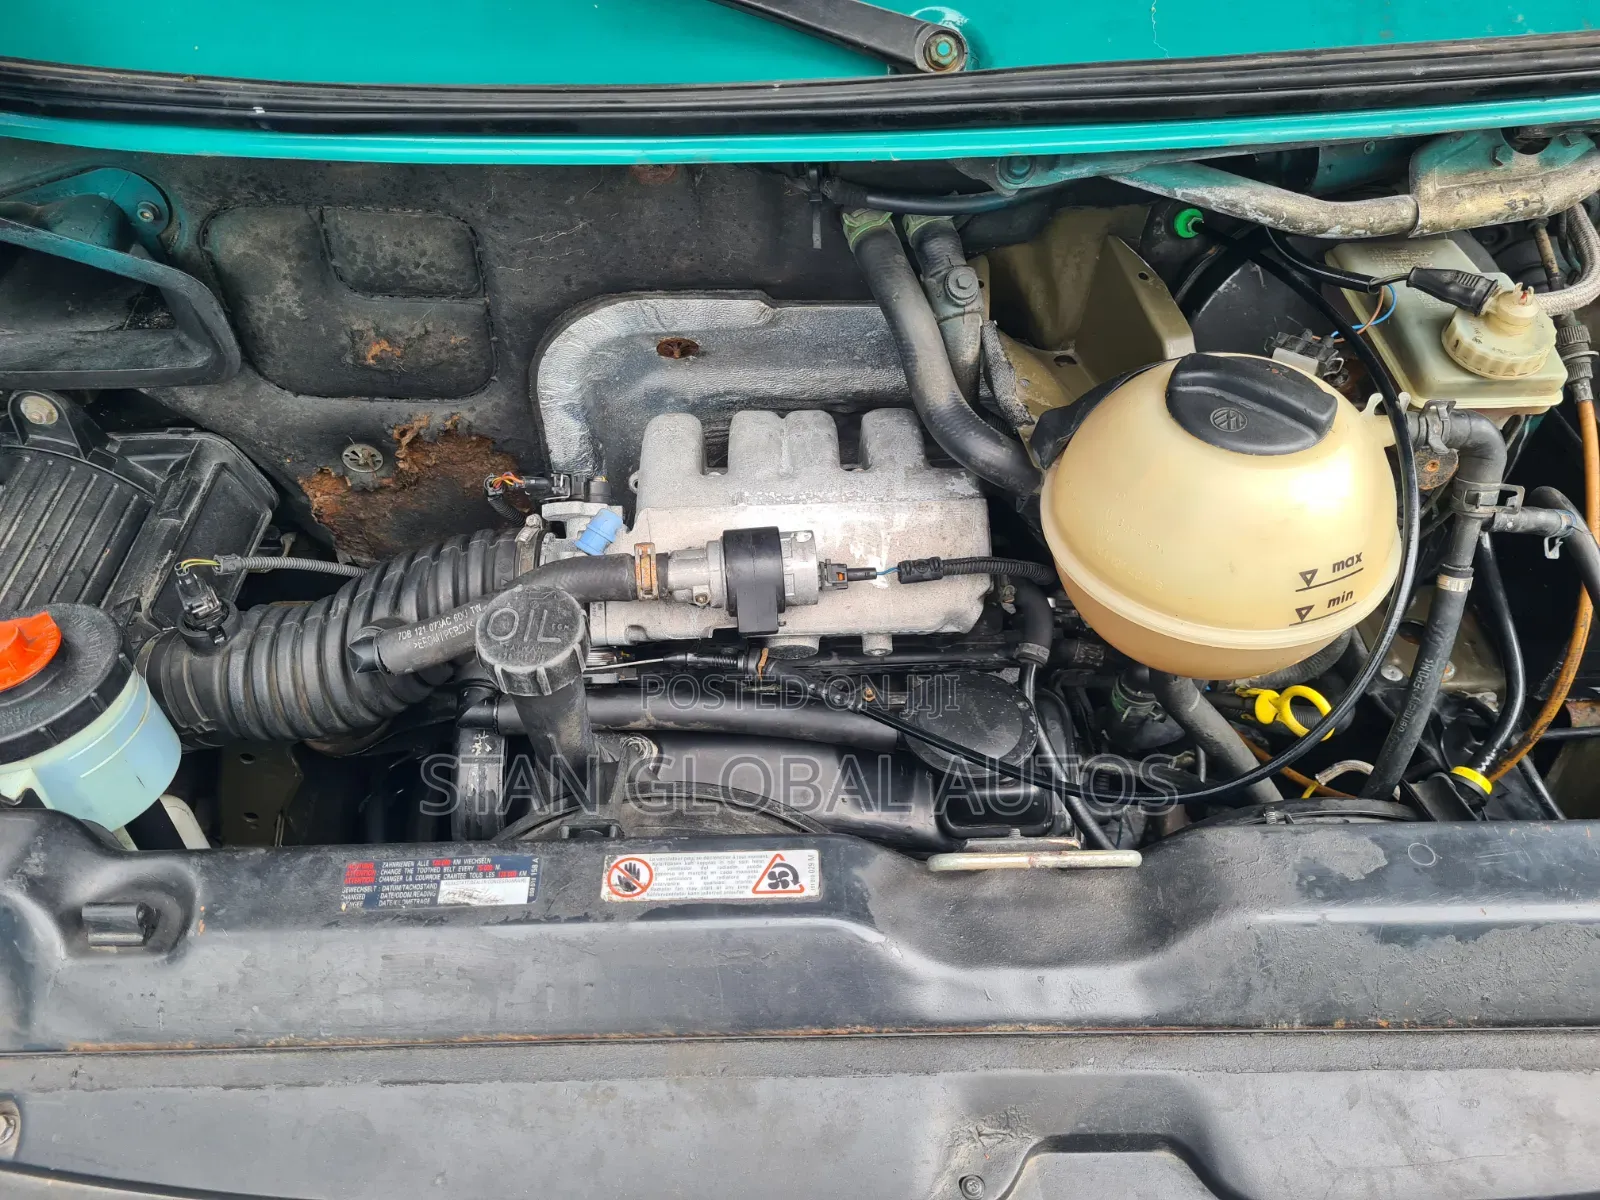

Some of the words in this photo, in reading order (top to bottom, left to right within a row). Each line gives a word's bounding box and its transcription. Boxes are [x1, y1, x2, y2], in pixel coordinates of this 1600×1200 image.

[1331, 552, 1363, 573] max
[1327, 590, 1354, 609] min
[486, 607, 562, 643] OIL
[380, 867, 402, 875] CHANGE
[417, 866, 440, 874] TOOTHED
[808, 862, 816, 874] 029
[379, 875, 403, 883] CHANGER
